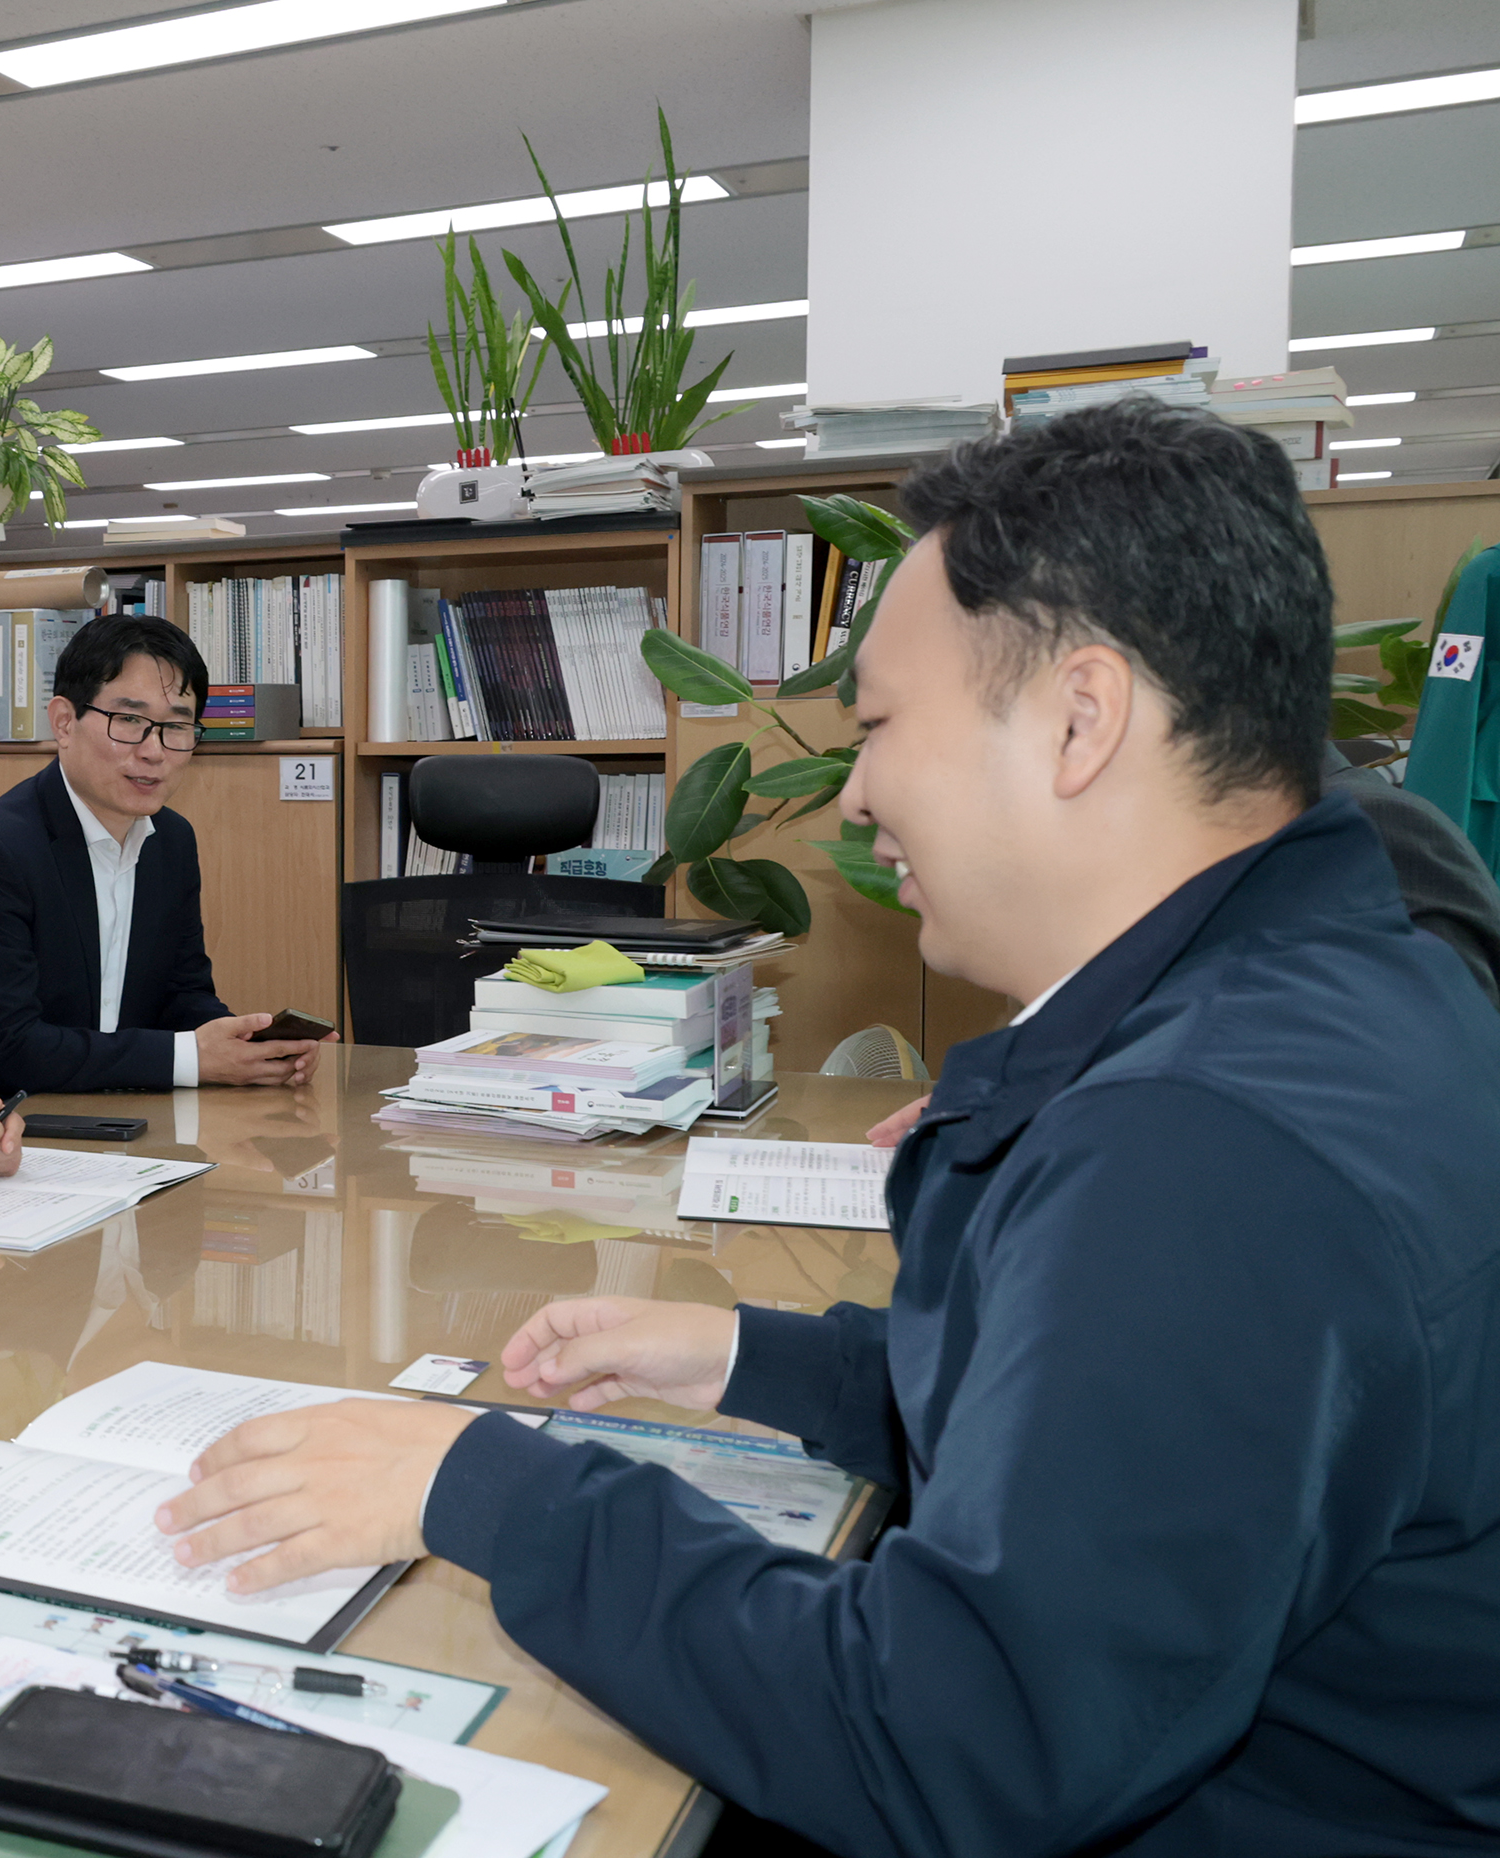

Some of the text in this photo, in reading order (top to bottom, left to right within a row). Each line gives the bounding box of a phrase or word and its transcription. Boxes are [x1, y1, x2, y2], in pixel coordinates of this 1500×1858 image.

[717, 586, 732, 638] 한국식품연감
[759, 584, 774, 636] 한국식품연감
[839, 571, 859, 628] CURRENCY
[295, 763, 315, 780] 21
